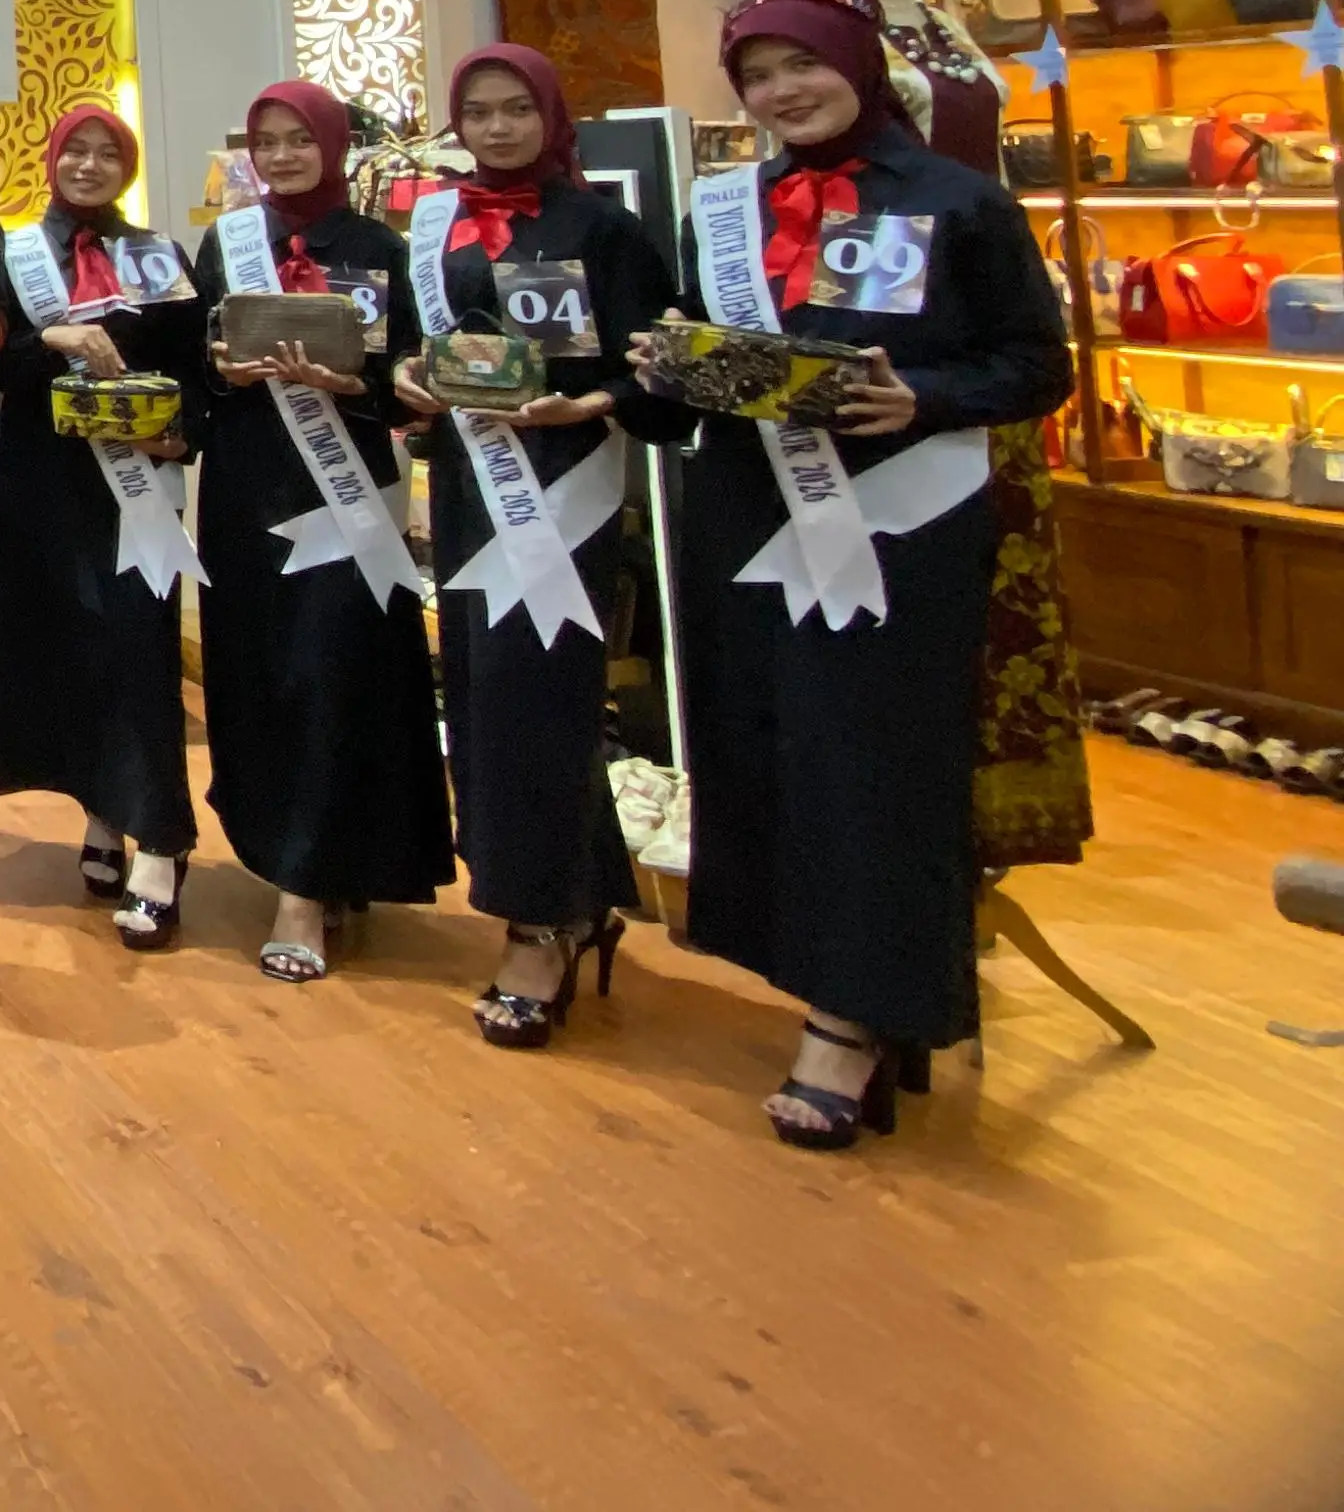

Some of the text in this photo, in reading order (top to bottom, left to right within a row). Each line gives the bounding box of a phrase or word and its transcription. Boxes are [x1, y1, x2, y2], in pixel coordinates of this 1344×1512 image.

[123, 252, 181, 285] 10
[235, 255, 271, 294] YOUT
[707, 204, 766, 331] YOUTH INFLUENC
[823, 238, 925, 289] 09
[20, 263, 59, 312] YOUTH
[351, 287, 378, 324] 8
[508, 288, 590, 334] 04
[115, 465, 154, 499] 2026
[302, 421, 348, 471] TIMUR
[328, 471, 369, 506] 2026
[479, 434, 523, 488] TIMUR
[791, 462, 842, 503] 2026
[499, 489, 541, 526] 2026
